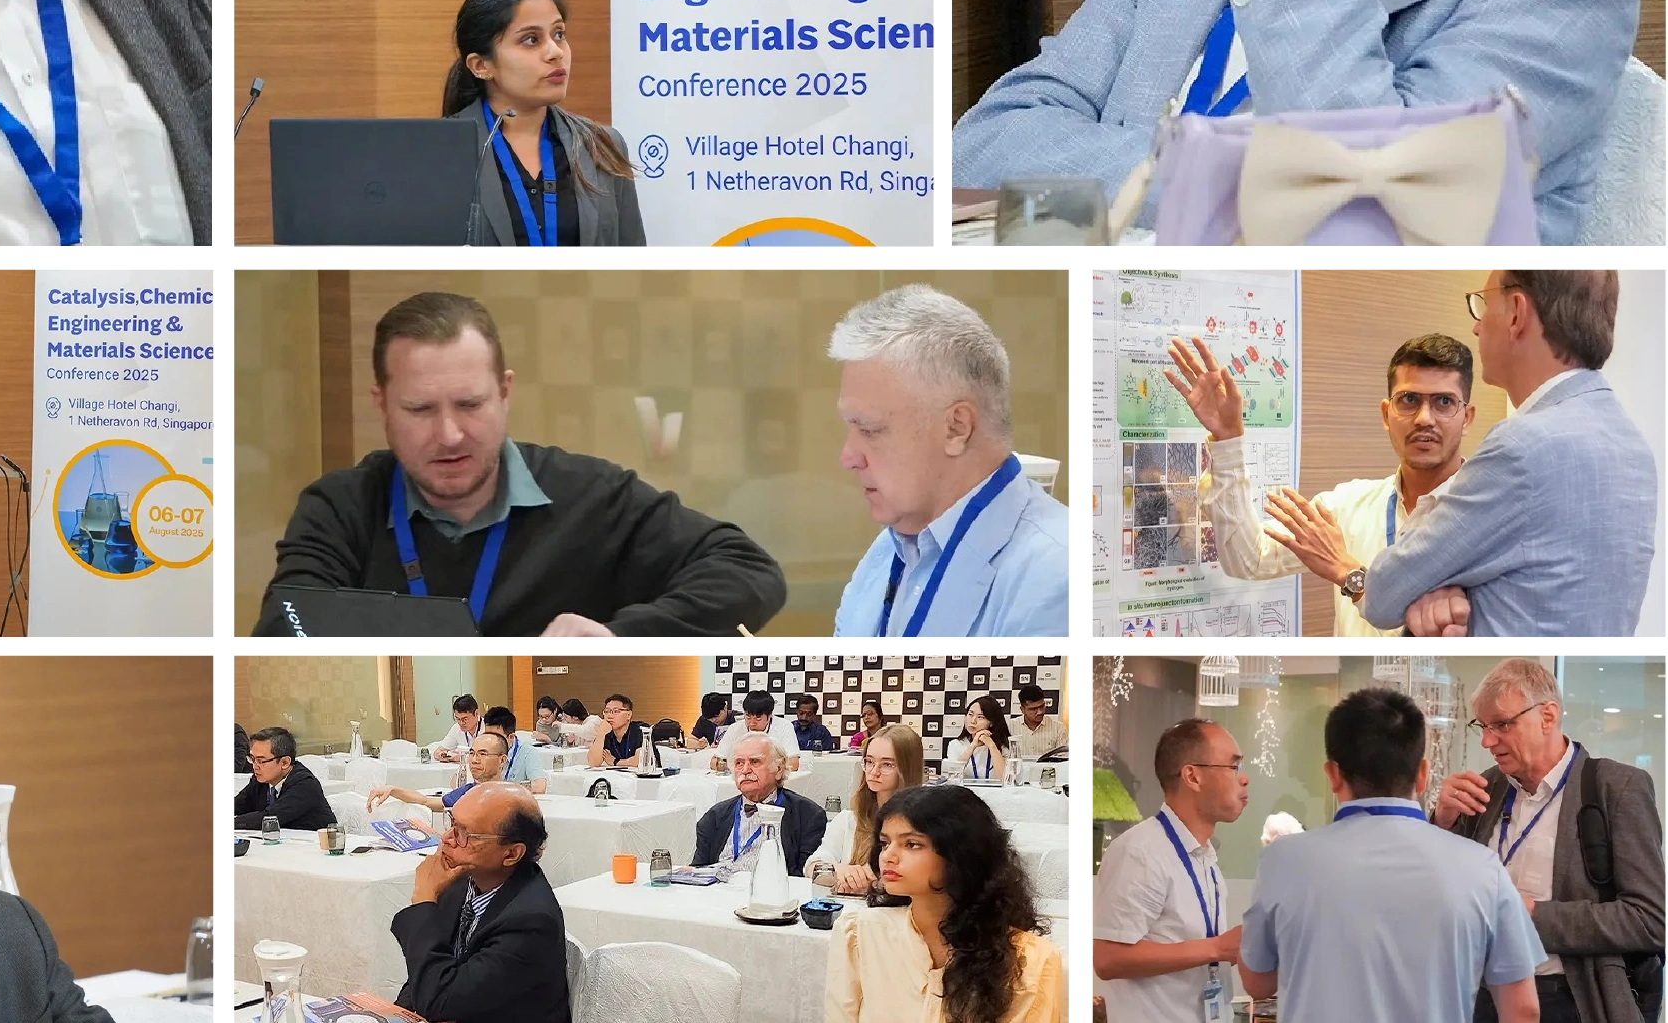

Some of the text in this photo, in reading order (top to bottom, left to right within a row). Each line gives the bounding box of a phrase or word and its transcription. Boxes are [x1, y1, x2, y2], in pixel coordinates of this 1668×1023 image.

[640, 19, 817, 52] Materials
[639, 72, 867, 97] Conference 2025
[685, 134, 914, 161] Village Hotel Changi,
[687, 171, 694, 190] 1
[707, 170, 831, 191] Netheravon
[841, 170, 873, 194] Rd,
[140, 288, 214, 304] Chemic
[48, 315, 183, 336] Engineering &
[47, 341, 215, 360] Materials Science
[47, 367, 159, 381] Conference 2025
[68, 398, 180, 414] Village Hotel Changi,
[69, 415, 73, 425] 1
[78, 415, 140, 427] Netheravon
[143, 417, 160, 429] Rd,
[149, 506, 204, 524] 06-07
[149, 526, 204, 538] August 2025
